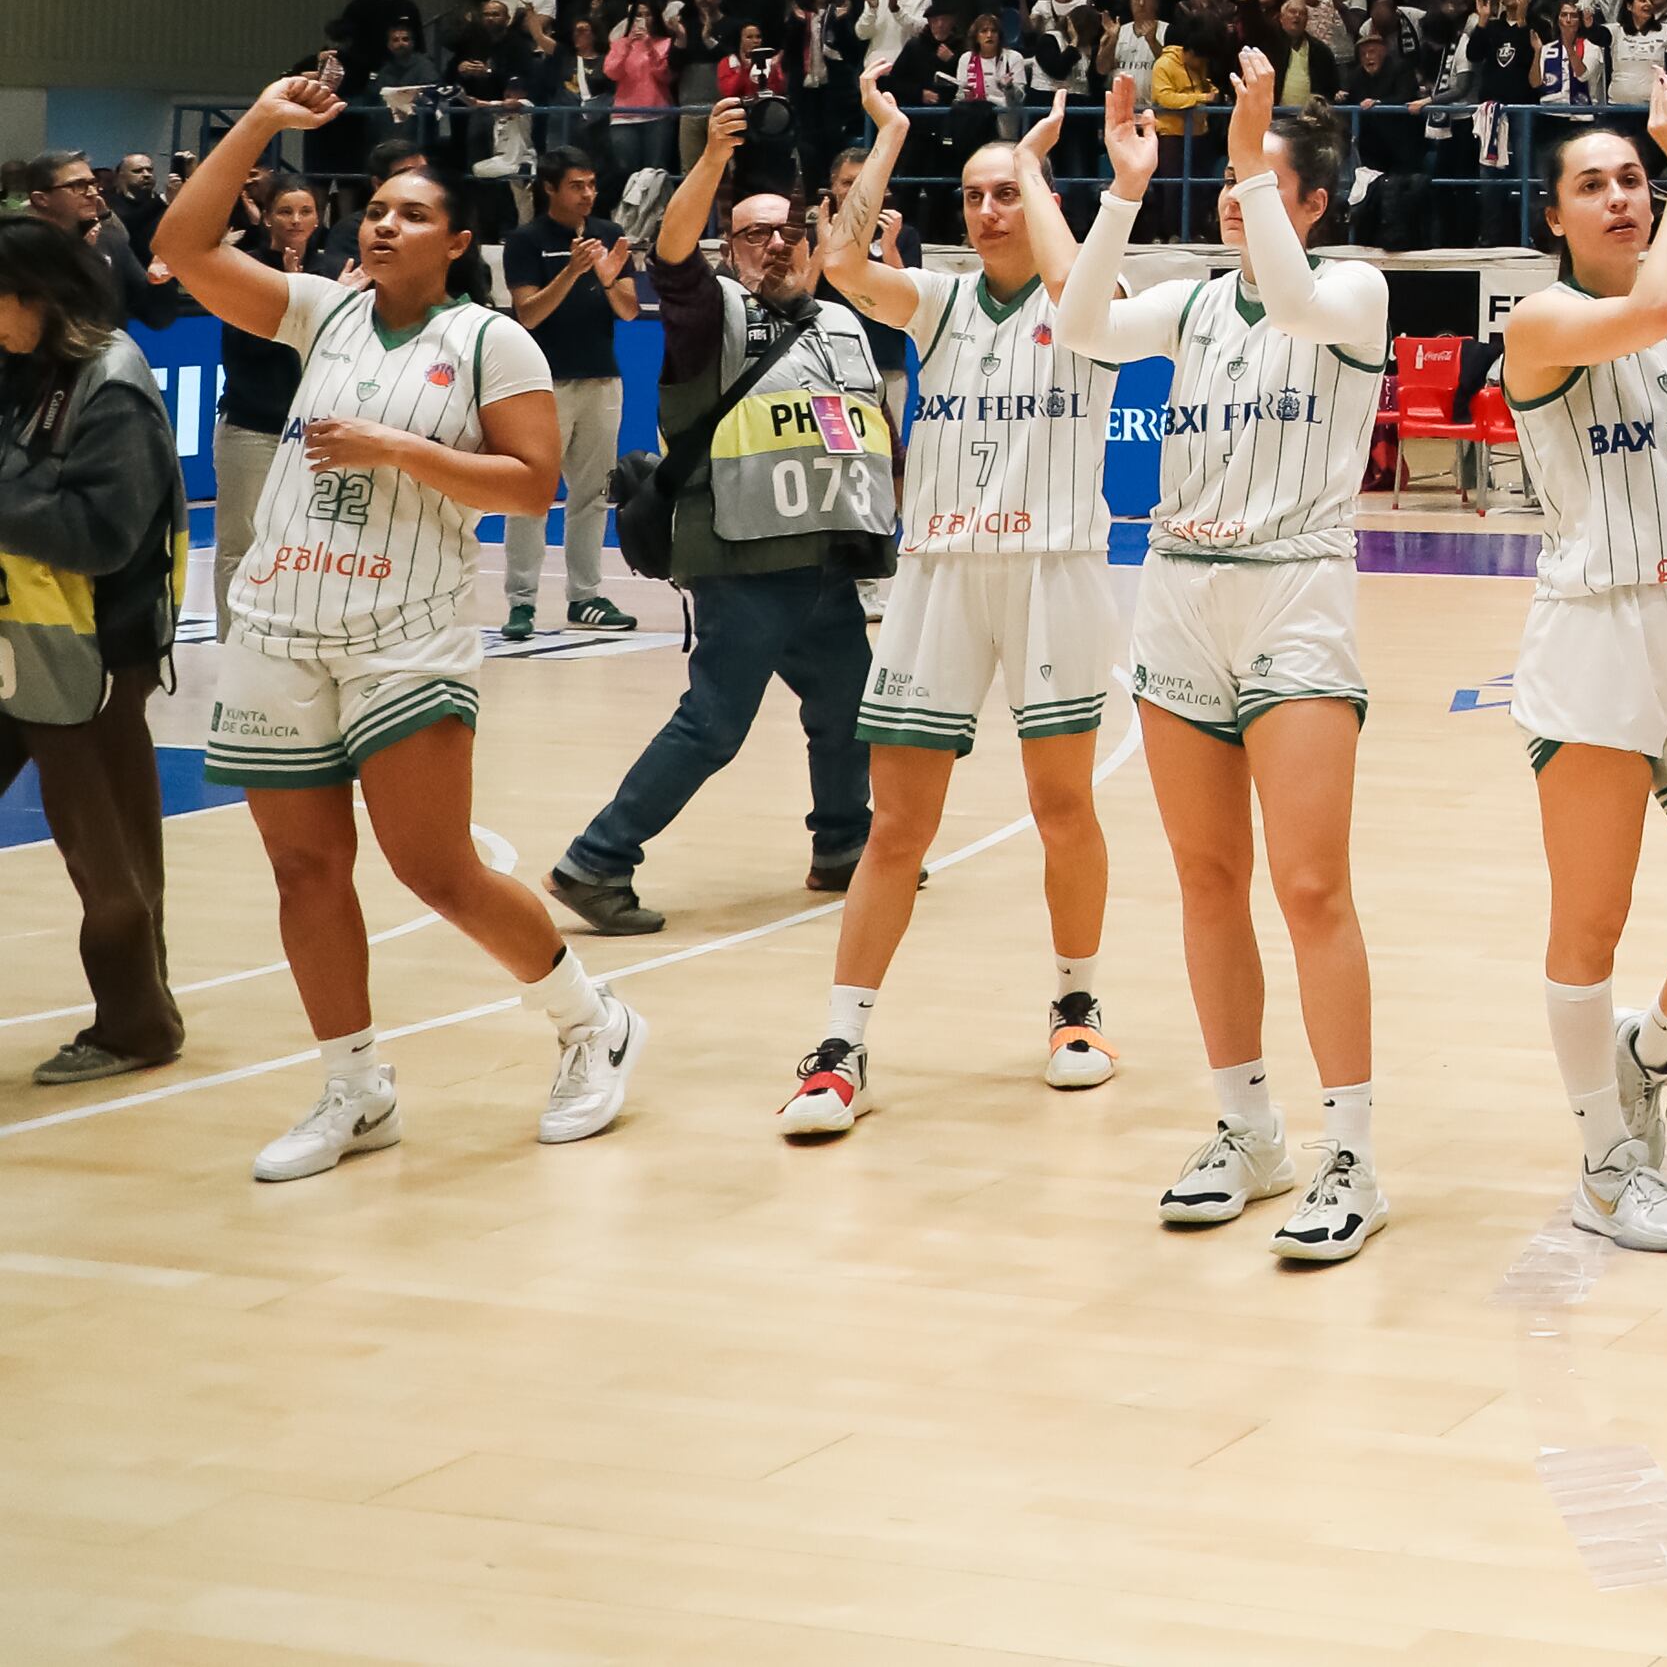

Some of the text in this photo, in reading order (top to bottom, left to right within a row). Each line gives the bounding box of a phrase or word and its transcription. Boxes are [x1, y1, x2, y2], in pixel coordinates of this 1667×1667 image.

[42, 389, 65, 430] Canon
[771, 455, 873, 519] 073
[971, 441, 998, 490] 7
[306, 470, 374, 527] 22
[904, 505, 1032, 553] galicia
[250, 541, 393, 584] galicia
[1149, 671, 1195, 690] XUNTA
[1166, 689, 1222, 707] GALICIA
[221, 721, 300, 738] DE GALICIA
